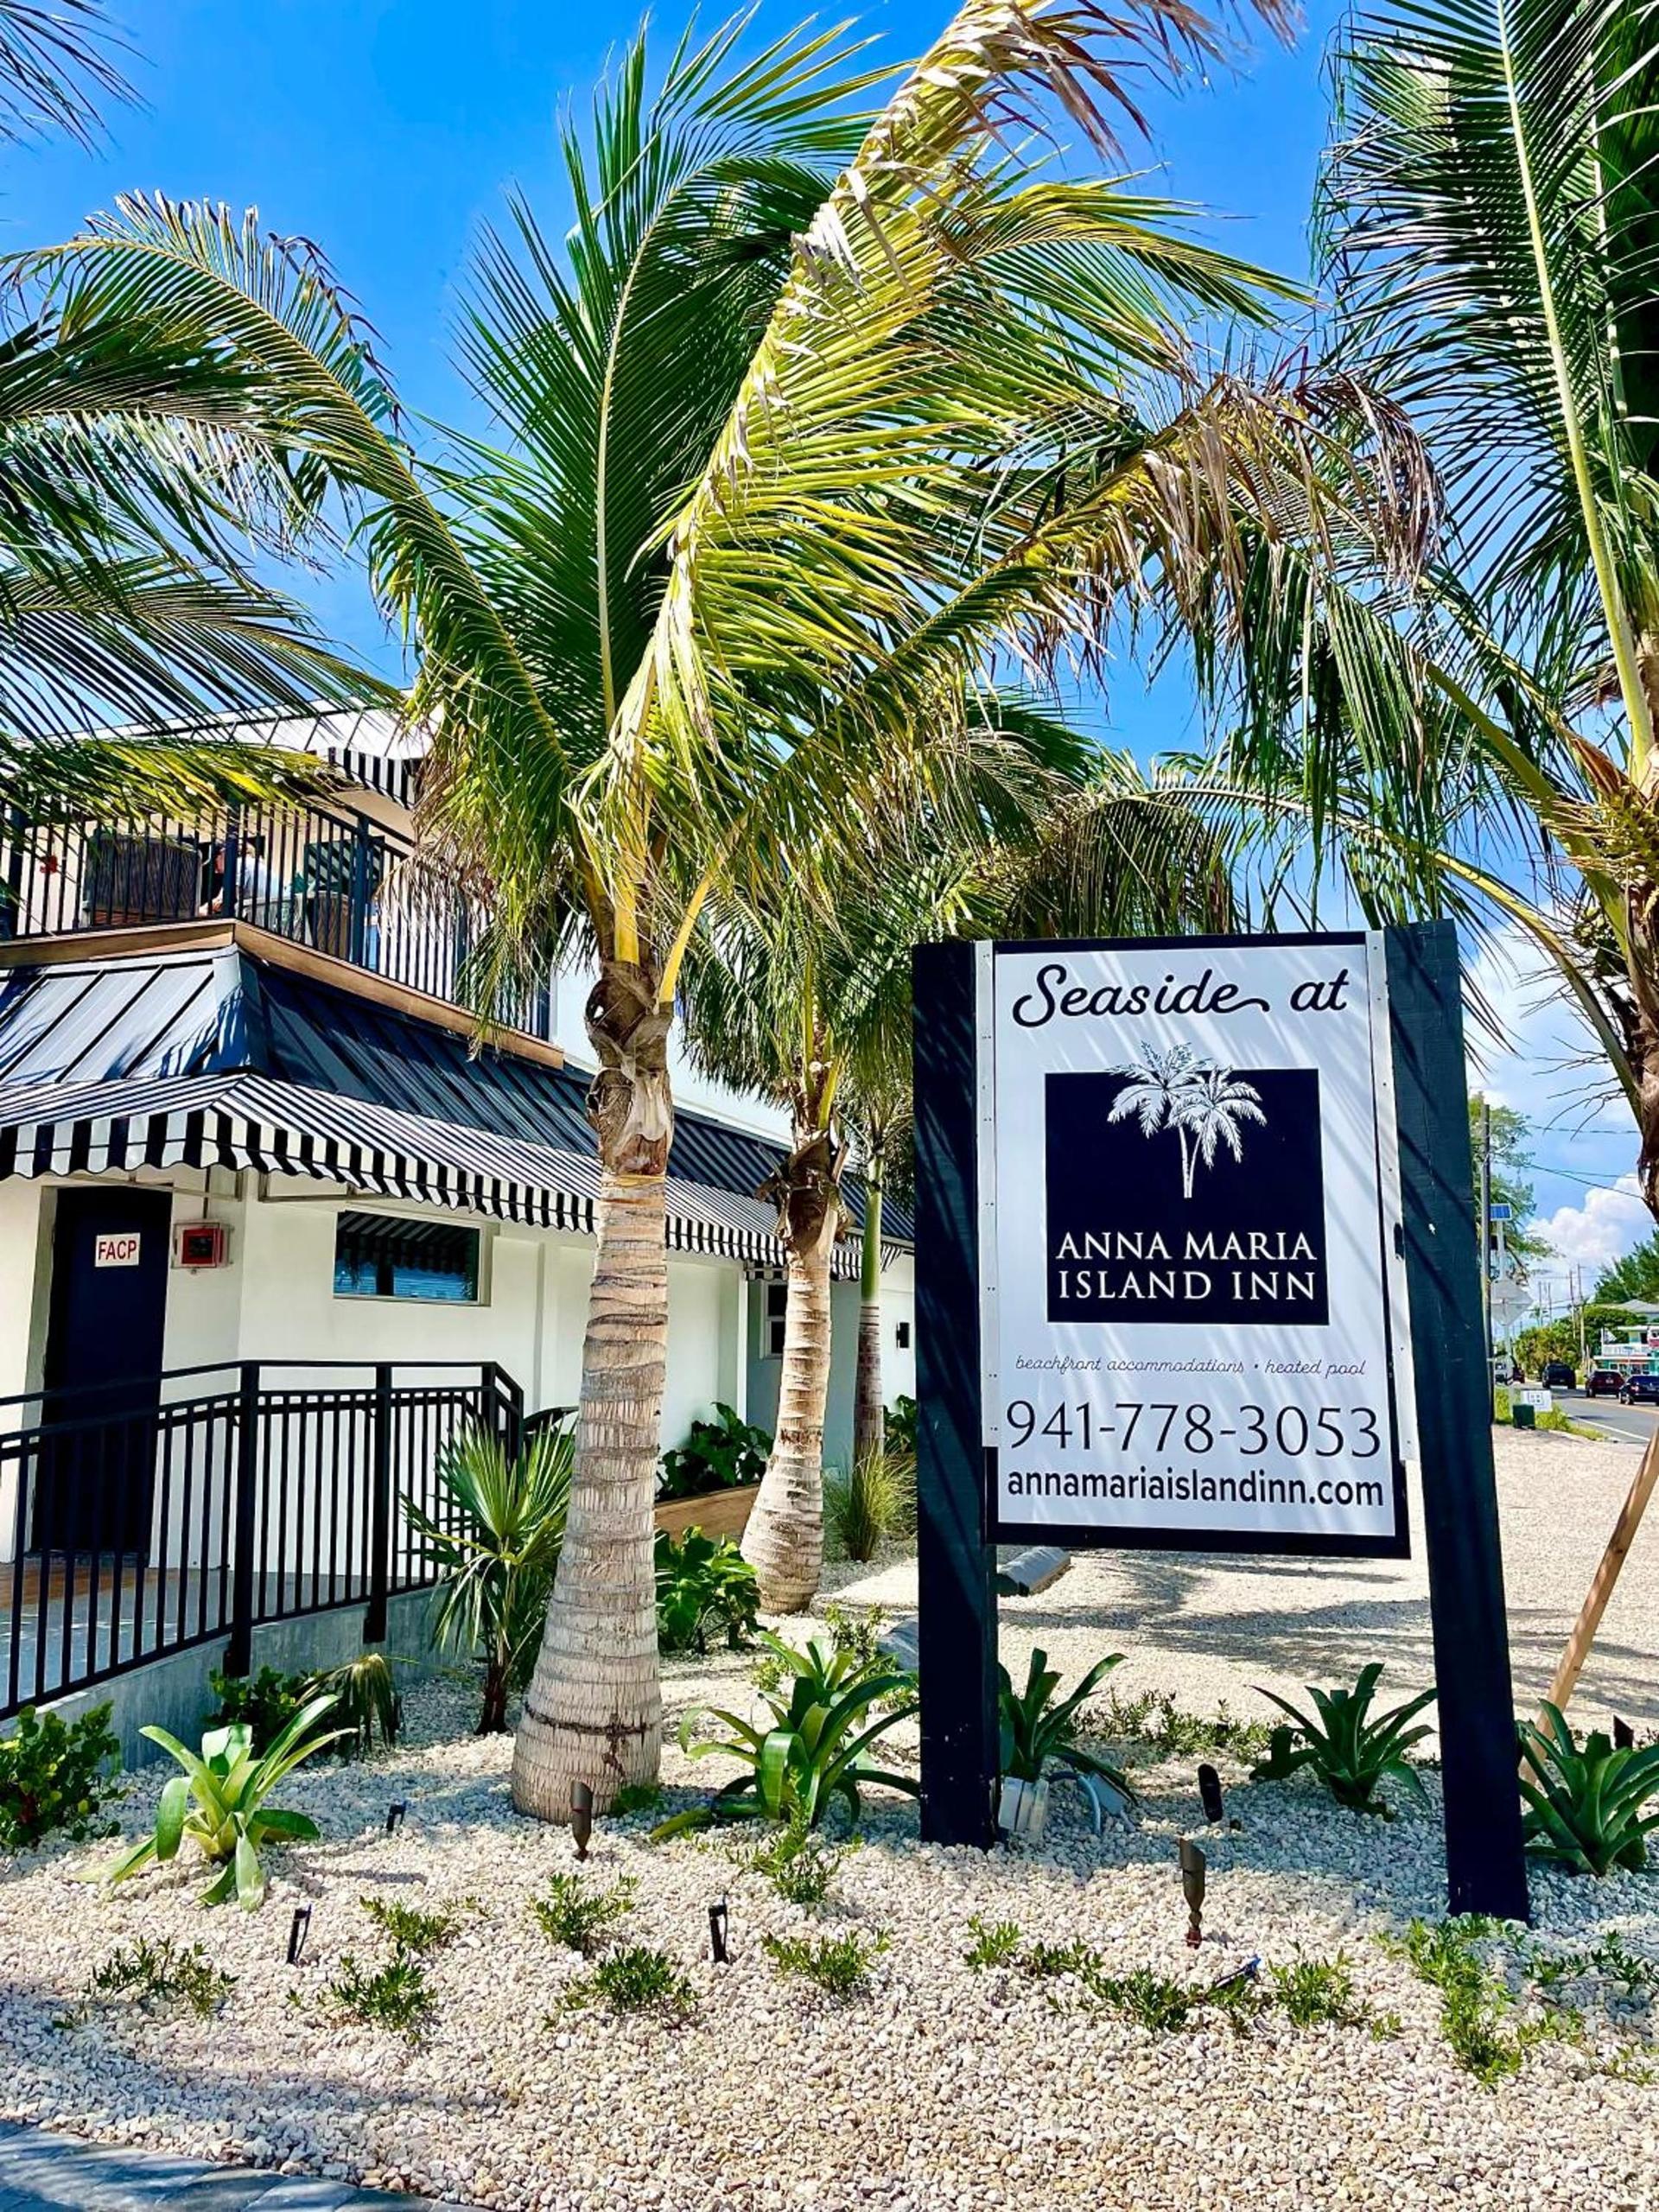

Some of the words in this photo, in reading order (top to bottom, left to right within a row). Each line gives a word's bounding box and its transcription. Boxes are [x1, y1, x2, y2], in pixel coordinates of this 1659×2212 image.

[1012, 963, 1270, 1027] Seaside
[1290, 968, 1351, 1011] at
[99, 1240, 137, 1260] FACP
[1056, 1231, 1173, 1260] ANNA
[1184, 1231, 1317, 1260] MARIA
[1058, 1270, 1211, 1300] ISLAND
[1232, 1271, 1315, 1300] INN
[1014, 1355, 1102, 1373] beachfront
[1106, 1357, 1245, 1374] accommodations
[1264, 1358, 1322, 1375] heated
[1325, 1359, 1365, 1377] pool
[1006, 1400, 1381, 1458] 941-778-3053
[1007, 1466, 1383, 1506] annamariaislandinn.com
